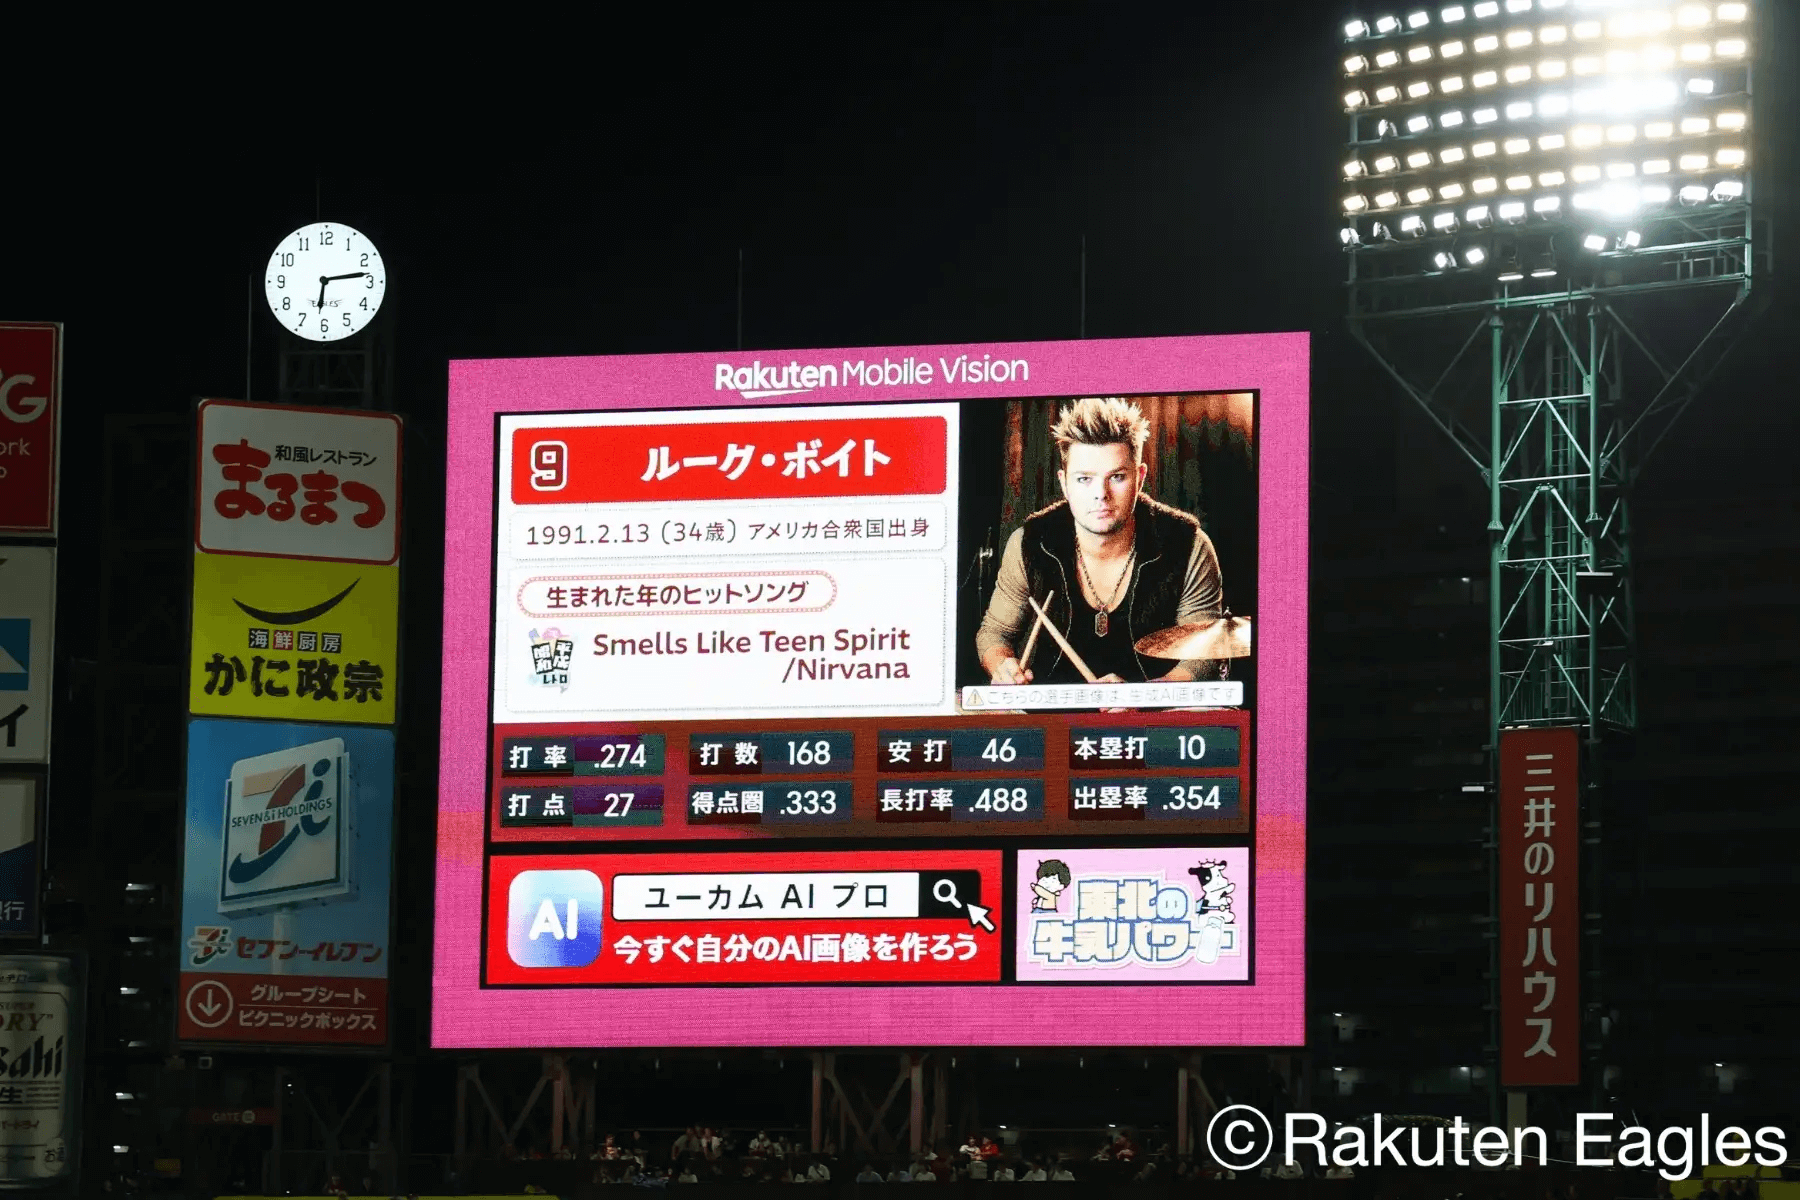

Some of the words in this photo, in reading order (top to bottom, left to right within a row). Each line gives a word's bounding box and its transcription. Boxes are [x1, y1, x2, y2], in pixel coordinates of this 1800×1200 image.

[299, 237, 309, 251] 11
[320, 231, 334, 246] 12
[346, 237, 351, 251] 1
[281, 253, 294, 267] 10
[360, 253, 369, 267] 2
[277, 275, 286, 289] 9
[366, 275, 374, 289] 3
[282, 297, 291, 311] 8
[359, 297, 368, 311] 4
[298, 312, 307, 327] 7
[320, 318, 329, 332] 6
[342, 312, 351, 327] 5
[715, 360, 838, 392] Rakuten
[842, 358, 933, 386] Mobile
[940, 354, 1030, 384] Vision
[274, 445, 377, 467] 和風レストラン
[530, 440, 568, 492] 9
[640, 438, 892, 482] ルーク・ボイト
[212, 438, 386, 529] まるまつ
[525, 522, 650, 547] 1991.2.13
[747, 516, 931, 542] アメリカ合衆国出身
[546, 580, 810, 609] 生まれた年のヒットソング
[248, 628, 342, 653] 海鮮厨房
[592, 631, 689, 657] Smells
[696, 629, 752, 656] Like
[758, 628, 826, 655] Teen
[833, 625, 912, 656] Spirit
[203, 652, 384, 704] かに政宗
[543, 673, 568, 685] レトロ
[781, 655, 912, 684] /Nirvana
[593, 744, 647, 768] .274
[788, 741, 831, 765] 168
[981, 738, 1017, 762] 46
[1178, 735, 1206, 760] 10
[277, 797, 333, 819] HOLDINGS
[603, 793, 635, 817] 27
[779, 790, 837, 815] .333
[968, 788, 1028, 812] .488
[1162, 786, 1222, 810] .354
[644, 883, 764, 911] ユーカム
[780, 883, 815, 909] AI
[834, 880, 889, 909] プロ
[1077, 879, 1188, 922] 東北の
[1523, 753, 1557, 1059] 三井のリハウス
[528, 898, 579, 940] AI
[613, 932, 978, 964] 今すぐ自分のAI画像を作ろう
[251, 984, 367, 1005] グループシート
[239, 1009, 377, 1031] ピクニックボックス
